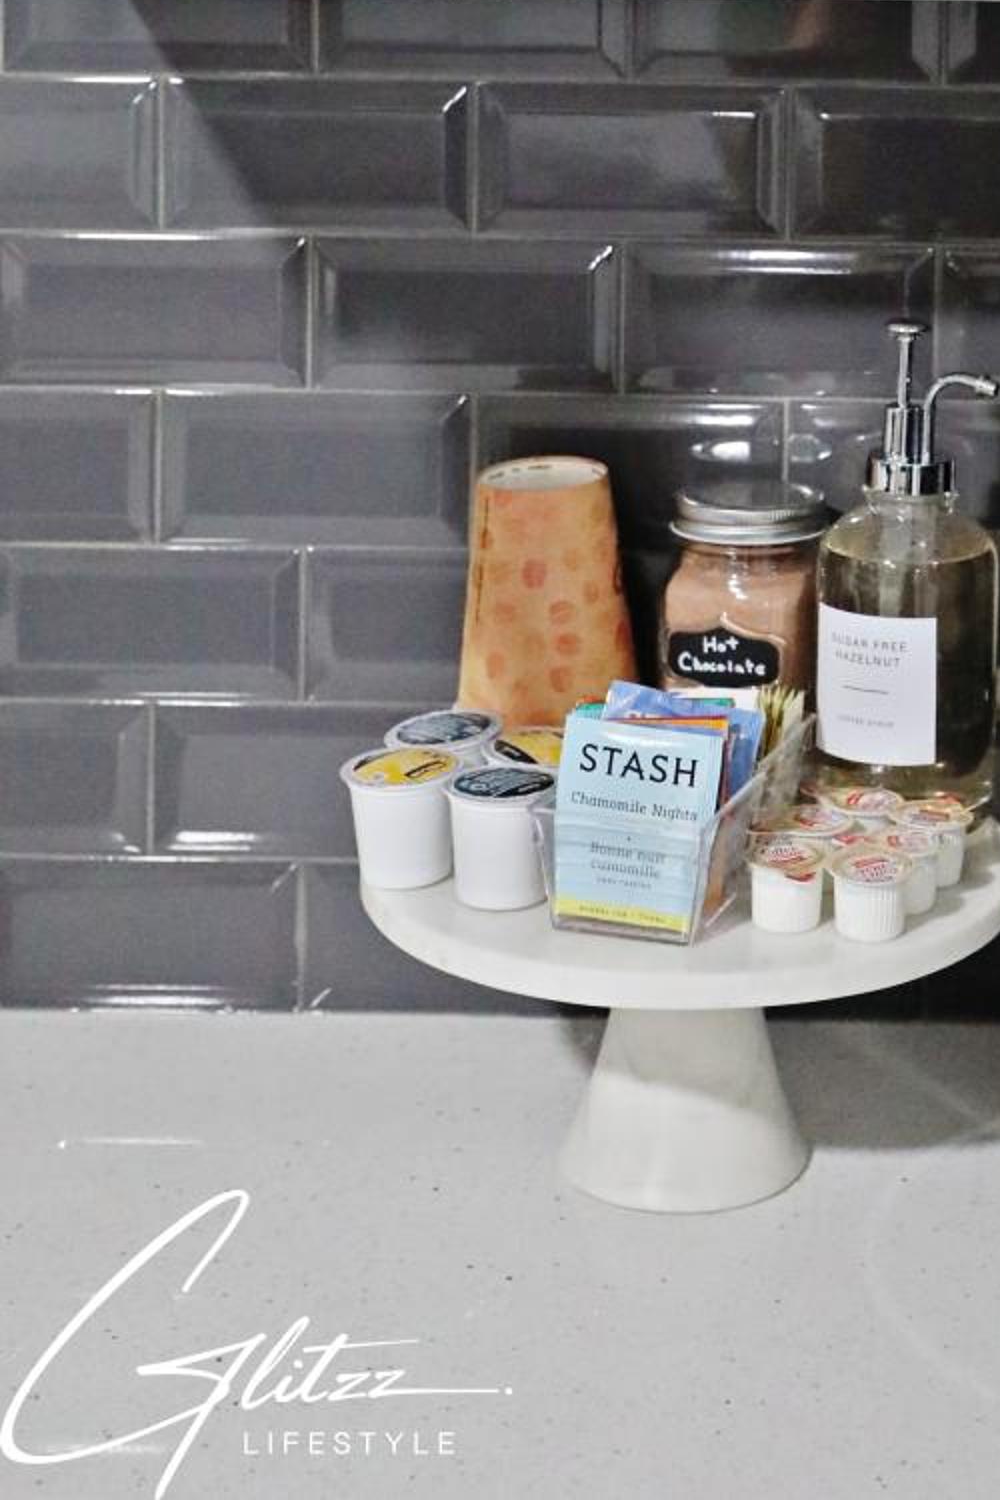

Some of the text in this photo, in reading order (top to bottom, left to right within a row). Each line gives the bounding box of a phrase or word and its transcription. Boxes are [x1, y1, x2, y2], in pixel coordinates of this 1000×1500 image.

[703, 635, 739, 654] Hot
[579, 743, 698, 788] STASH
[571, 791, 698, 822] Chamomile Nights
